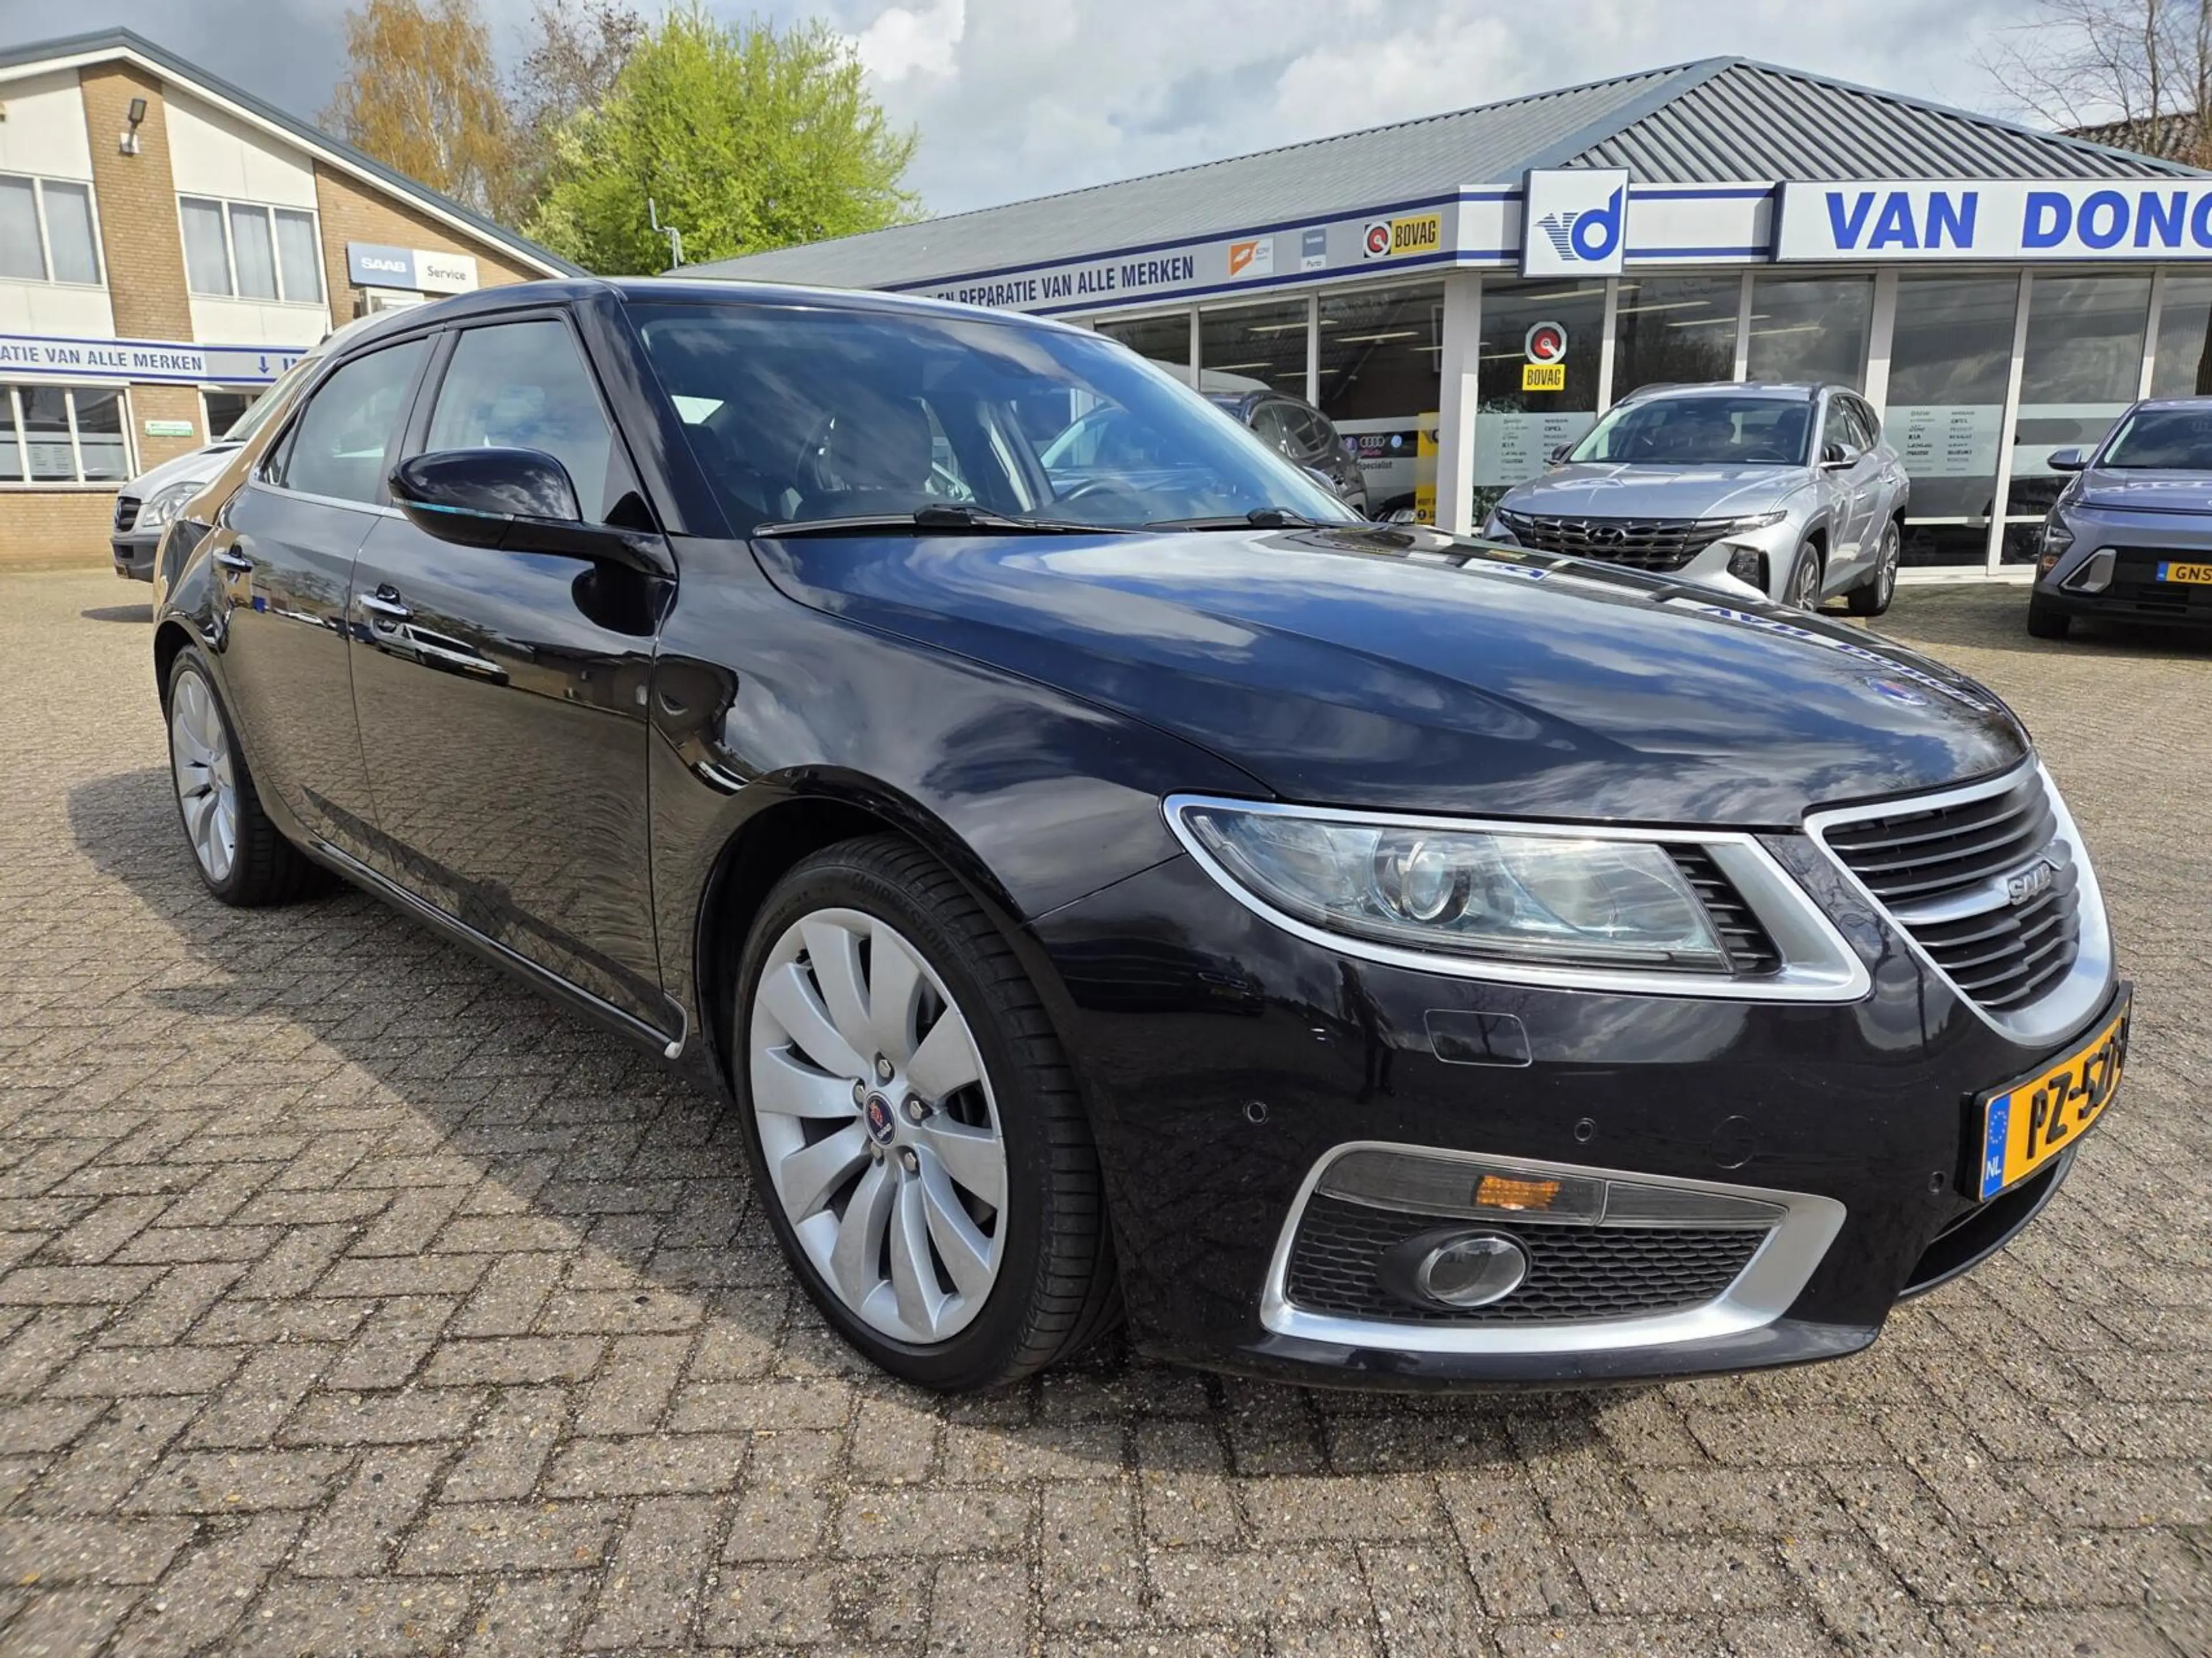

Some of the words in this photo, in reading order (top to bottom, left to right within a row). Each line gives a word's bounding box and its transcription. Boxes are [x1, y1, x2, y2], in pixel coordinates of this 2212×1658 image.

[1825, 192, 1979, 249] VAN
[1395, 220, 1435, 248] BOVAG
[361, 258, 407, 273] SAAB
[427, 265, 467, 281] Service
[960, 280, 1036, 306] REPARATIE
[1041, 274, 1072, 299] VAN
[1077, 267, 1115, 294] ALLE
[1121, 255, 1194, 289] MERKEN
[0, 346, 39, 362] ATIE
[44, 347, 80, 364] VAN
[88, 350, 127, 367] ALLE
[133, 352, 202, 371] MERKEN
[1527, 369, 1561, 385] BOVAG
[1985, 1156, 2002, 1181] NL
